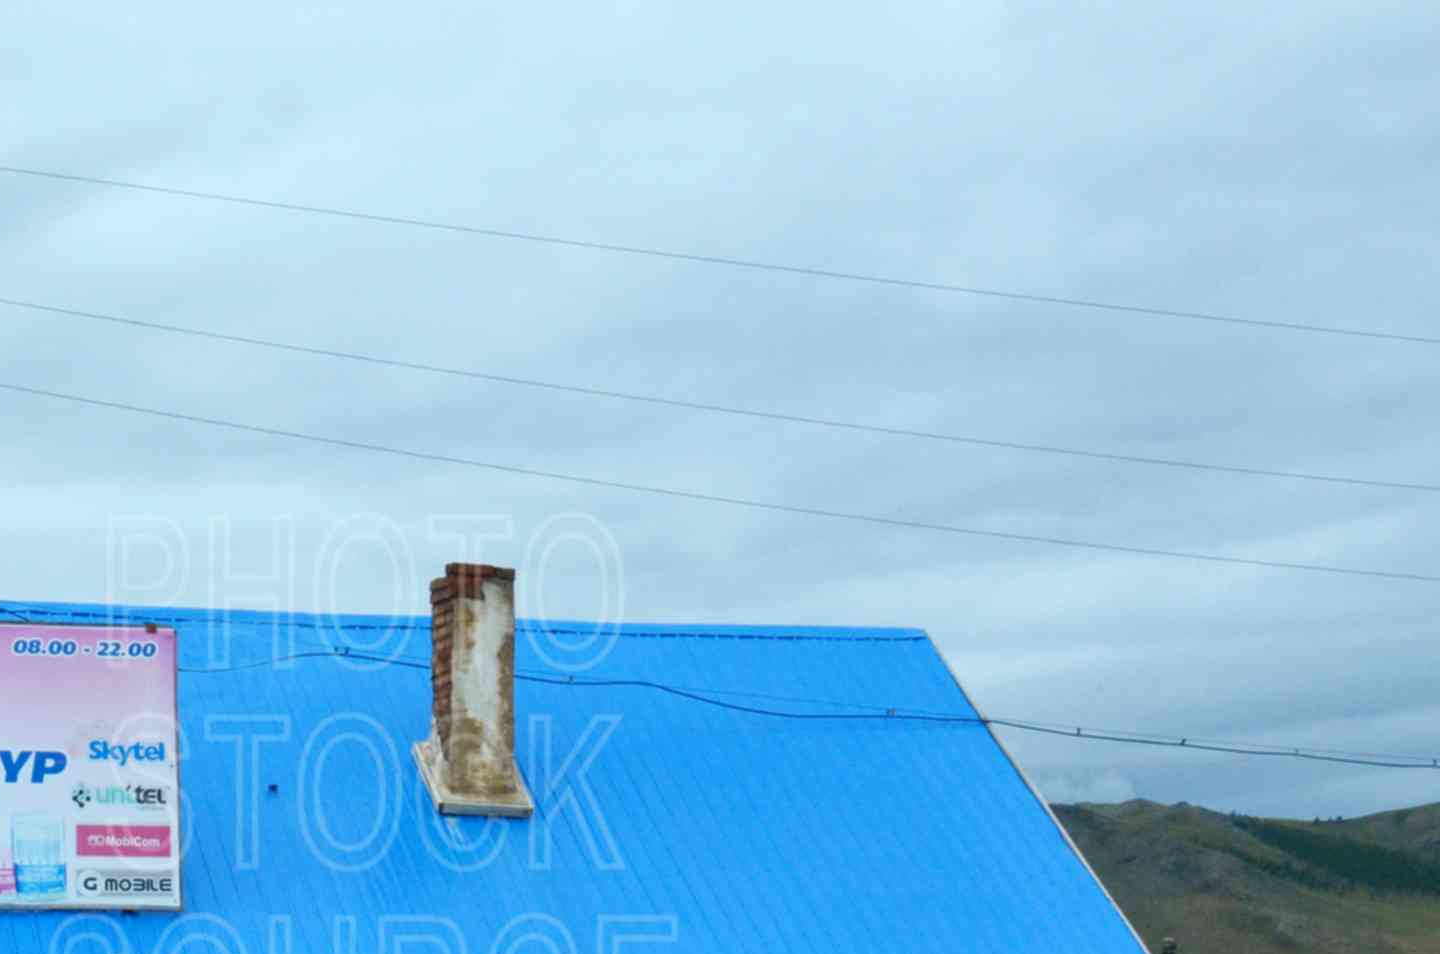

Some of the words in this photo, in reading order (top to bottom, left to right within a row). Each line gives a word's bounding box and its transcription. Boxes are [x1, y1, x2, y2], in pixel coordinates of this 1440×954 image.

[13, 640, 77, 655] 08.00
[97, 643, 156, 657] 22.00
[89, 739, 165, 766] Skytel
